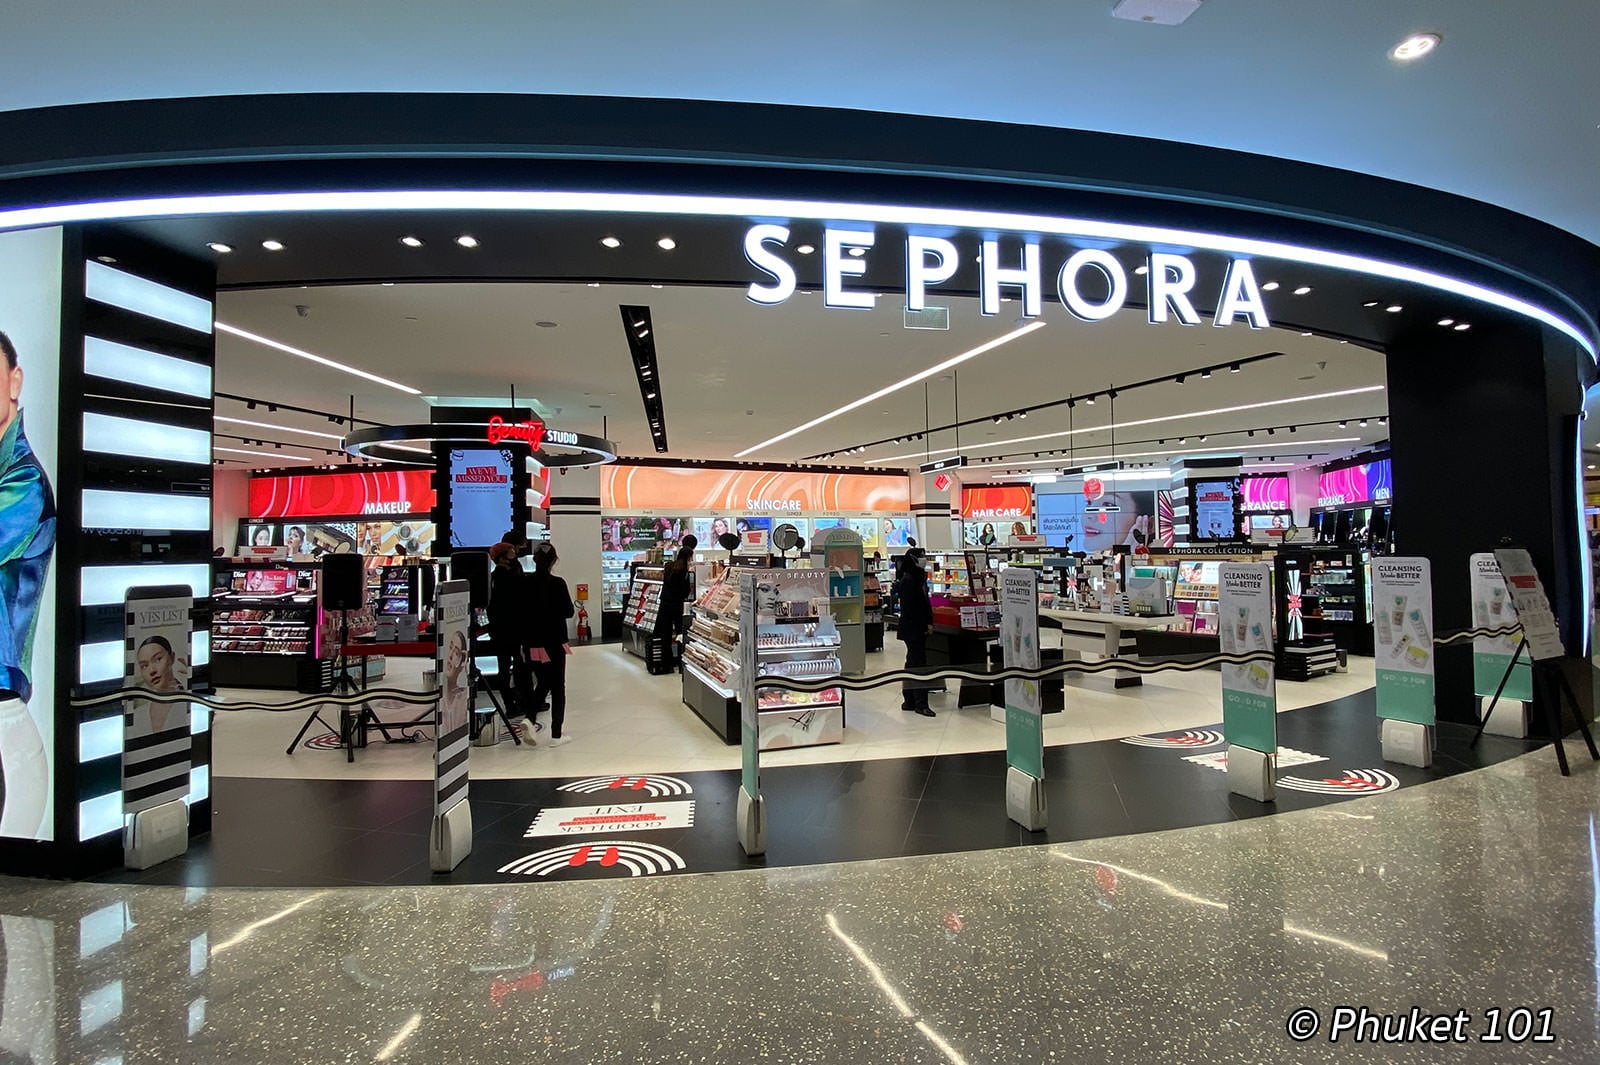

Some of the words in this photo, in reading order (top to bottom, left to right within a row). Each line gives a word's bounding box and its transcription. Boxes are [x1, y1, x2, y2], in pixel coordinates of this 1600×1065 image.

[743, 223, 1271, 330] SEPHORA
[547, 430, 578, 444] STUDIO
[1375, 487, 1389, 499] MEN
[364, 501, 411, 514] MAKEUP
[747, 499, 801, 511] SKINCARE
[786, 571, 826, 579] BEAUTY
[1223, 572, 1263, 581] CLEANSING
[1005, 578, 1032, 588] CLEANSING
[1239, 580, 1262, 589] BETTER
